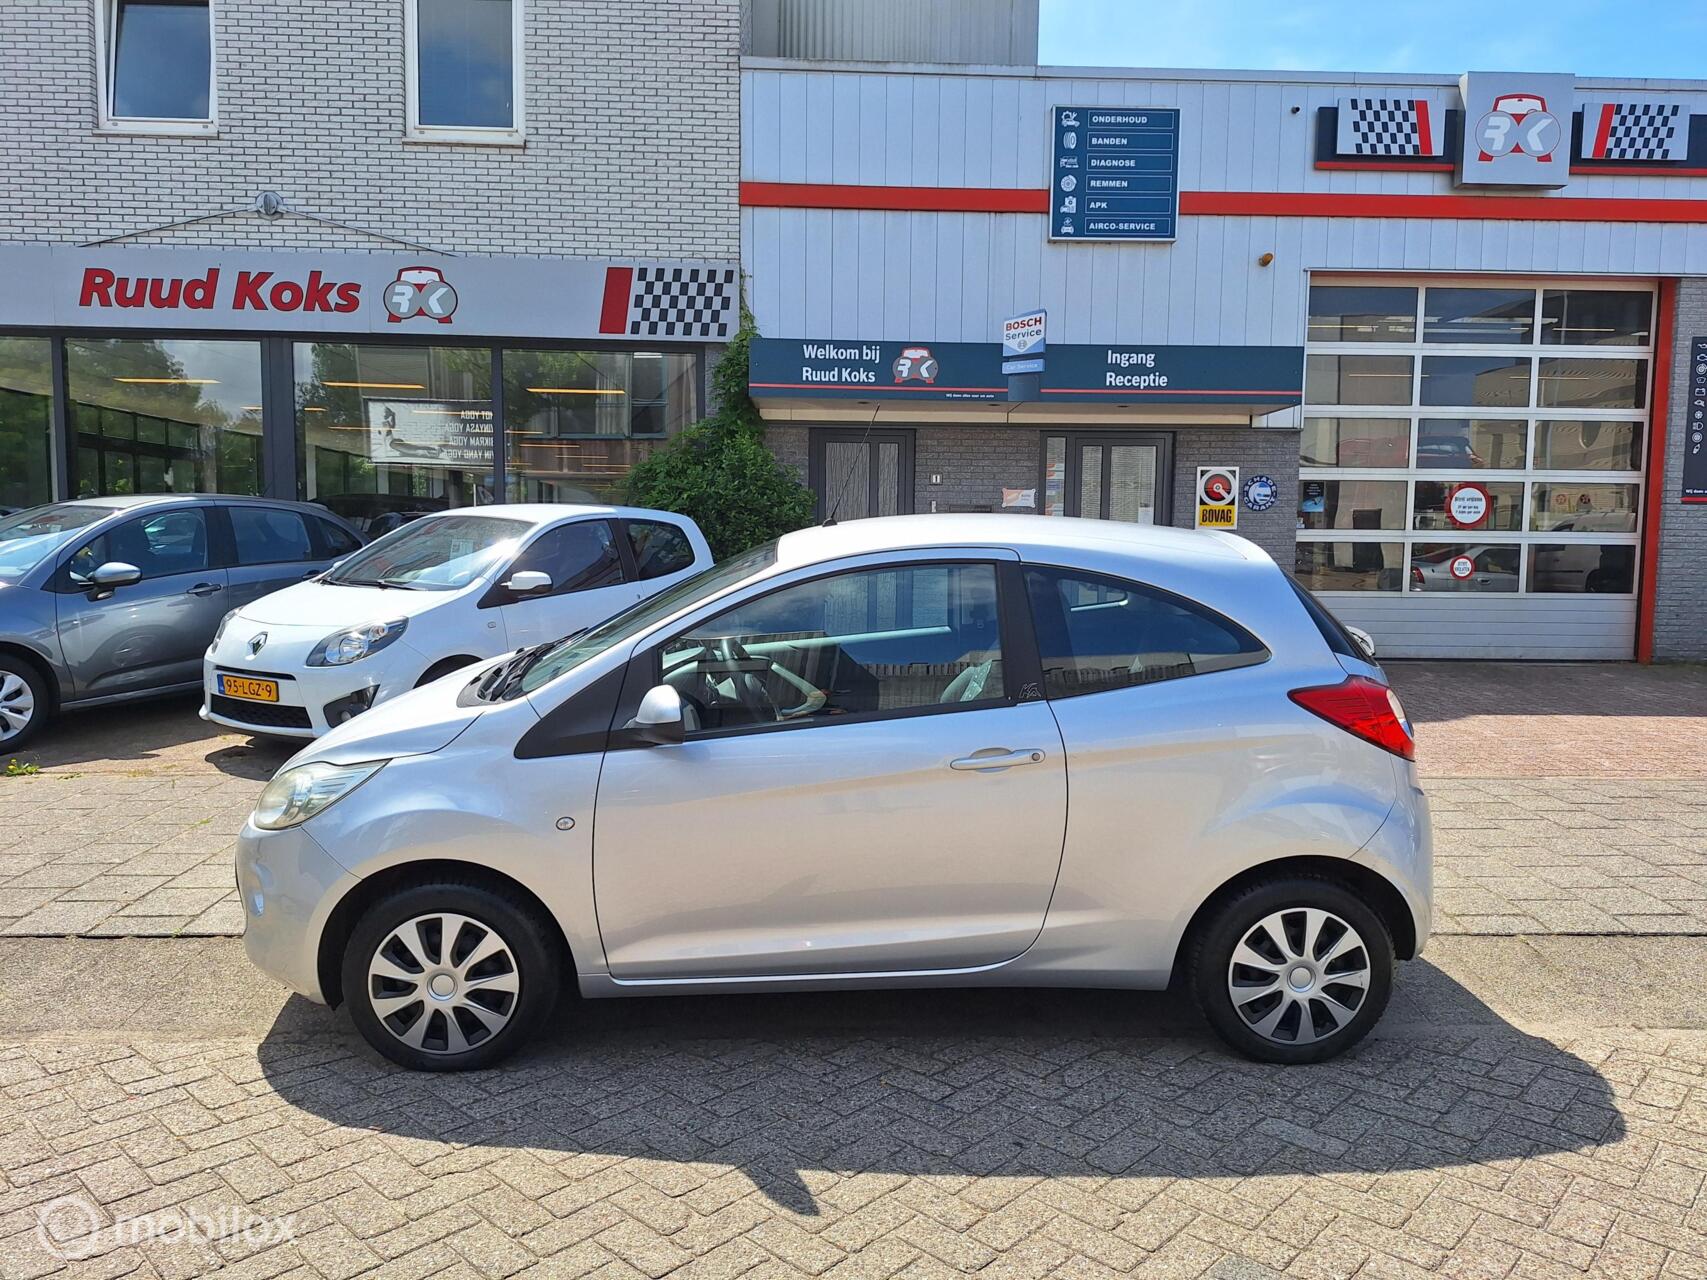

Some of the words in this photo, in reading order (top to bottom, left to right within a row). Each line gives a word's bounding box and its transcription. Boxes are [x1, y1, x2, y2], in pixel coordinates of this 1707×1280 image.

[1092, 115, 1148, 124] ONDERHOUD
[1091, 137, 1128, 145] BANDEN
[1090, 159, 1136, 167] DIAGNOSE
[1090, 180, 1128, 188] REMMEN
[1089, 201, 1108, 209] APK
[1089, 222, 1156, 230] AIRCO-SERVICE
[79, 267, 221, 310] Ruud
[232, 270, 362, 313] Koks
[1005, 316, 1042, 332] BOSCH
[1005, 328, 1042, 341] Service
[802, 344, 860, 361] Welkom
[862, 345, 881, 364] bij
[1107, 349, 1156, 368] Ingang
[802, 366, 839, 382] Ruud
[841, 367, 876, 383] Koks
[1105, 372, 1168, 390] Receptie
[1243, 476, 1277, 492] SCHADE
[1201, 508, 1232, 523] BOVAG
[226, 679, 272, 697] 95-LGZ-9
